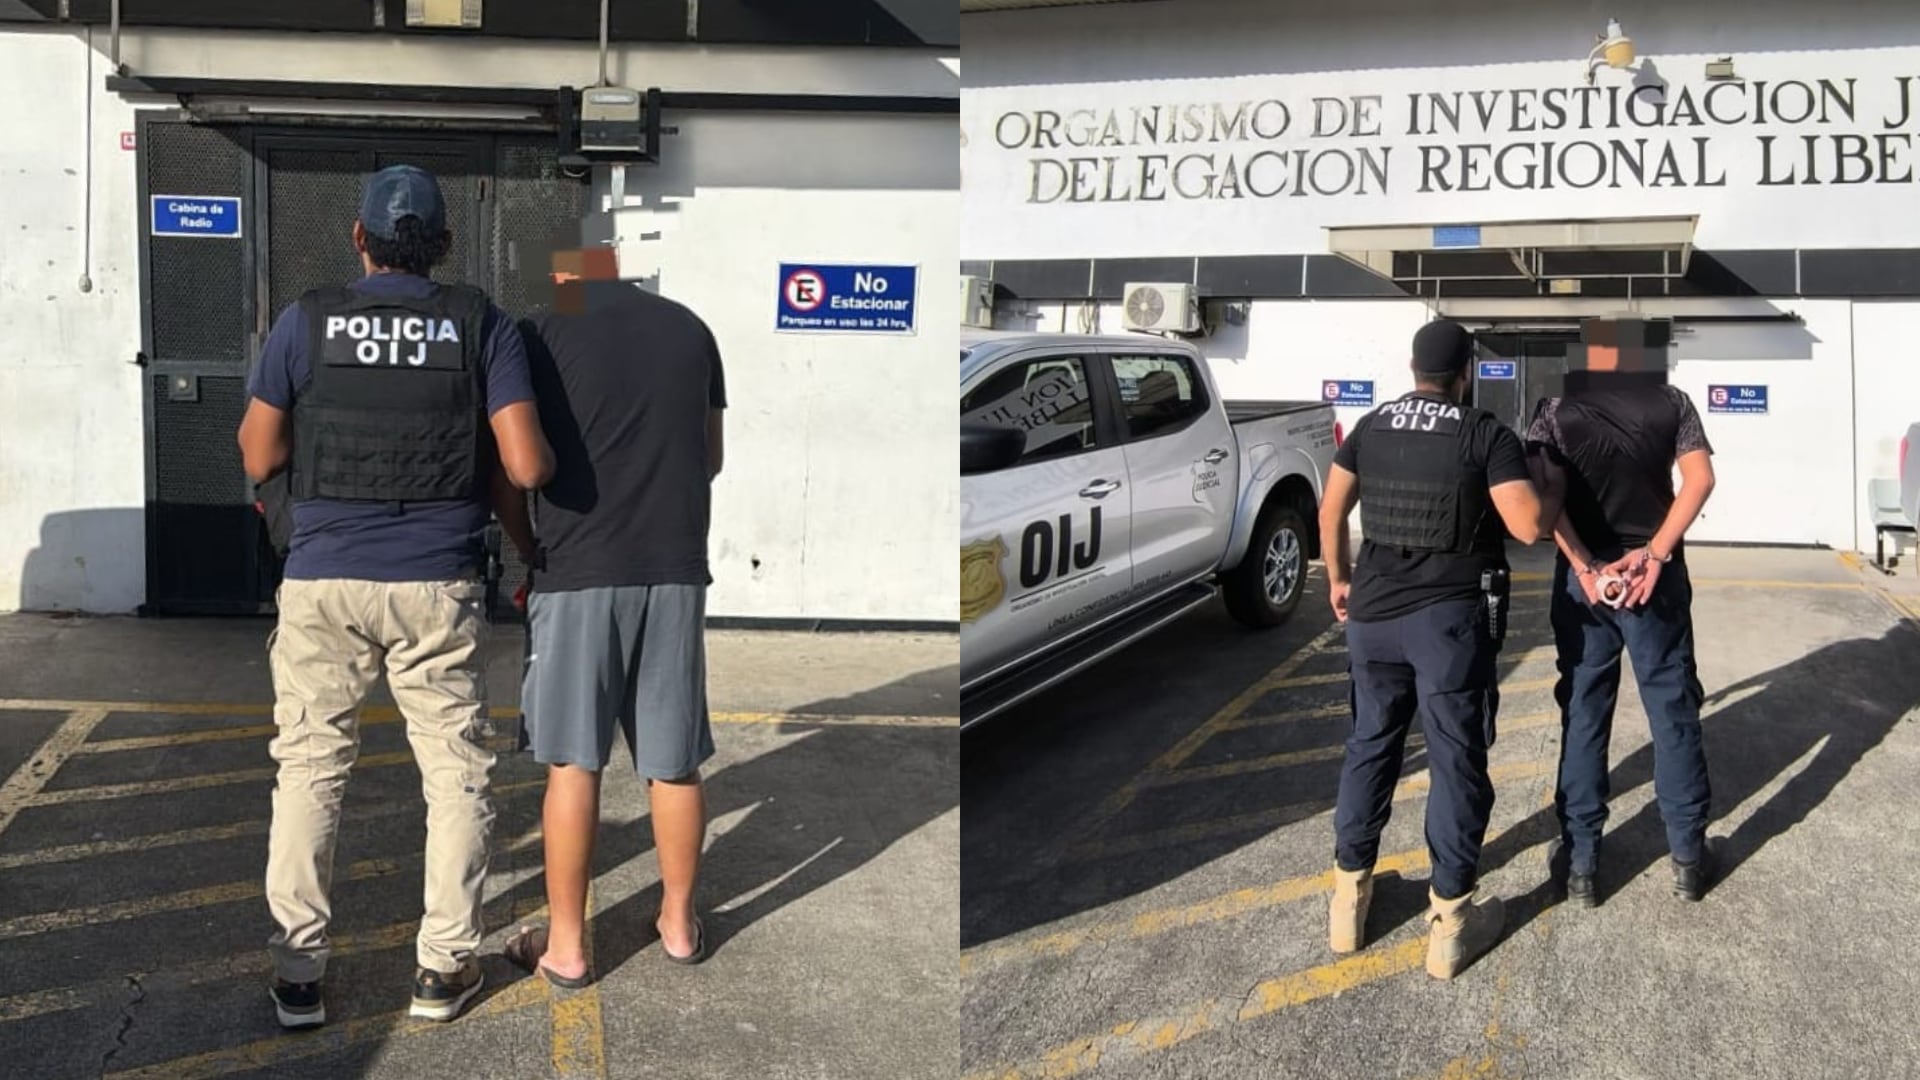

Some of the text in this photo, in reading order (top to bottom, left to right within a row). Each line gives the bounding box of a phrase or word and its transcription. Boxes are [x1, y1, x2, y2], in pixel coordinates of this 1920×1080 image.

[995, 98, 1291, 150] ORGANISMO
[1310, 94, 1382, 138] DE
[1405, 77, 1857, 135] INVESTIGACION
[1883, 76, 1920, 129] J
[1026, 132, 1920, 204] DELEGACION REGIONAL LIBE
[168, 202, 224, 215] Cabina de
[180, 216, 213, 228] Radio
[853, 271, 888, 293] No
[830, 294, 909, 311] Estacionar
[326, 315, 459, 342] POLICIA
[876, 317, 888, 327] 24
[1740, 387, 1756, 397] No
[1379, 399, 1461, 420] POLICIA
[1020, 505, 1102, 589] OIJ
